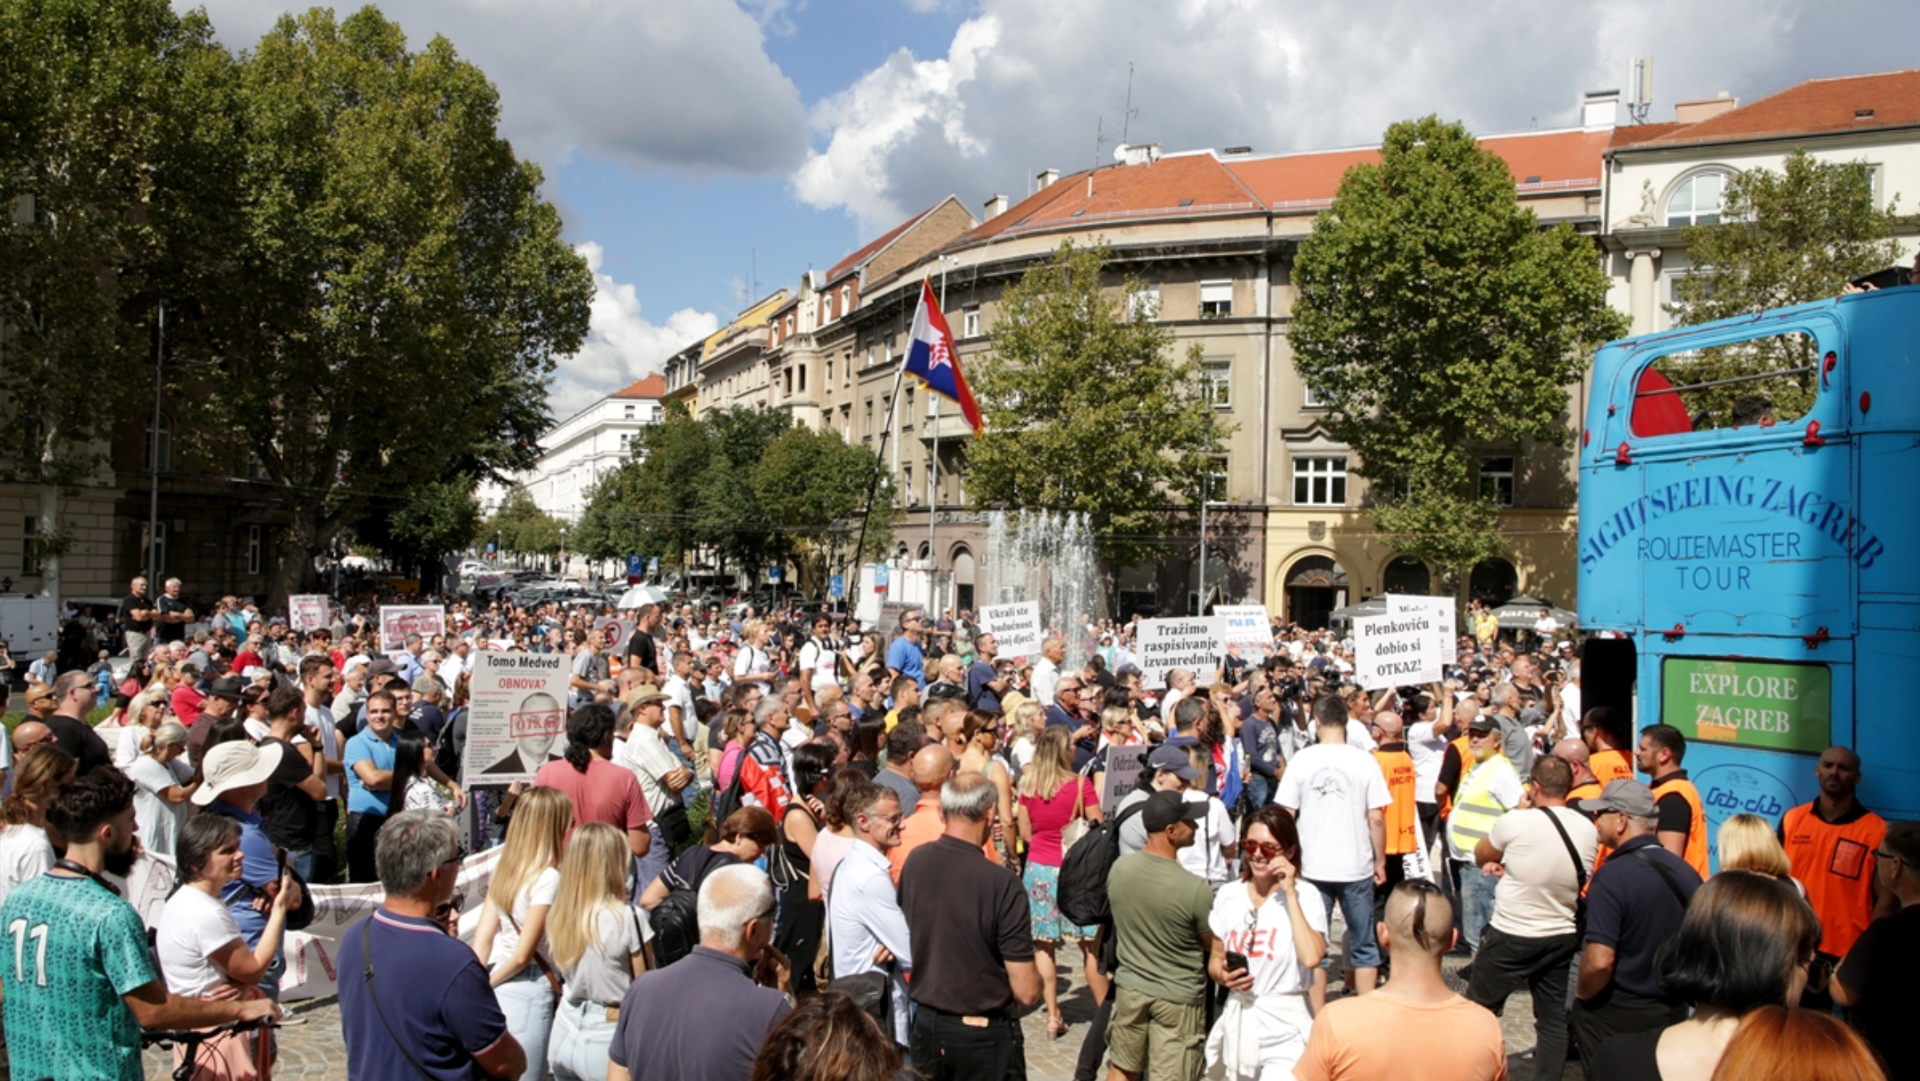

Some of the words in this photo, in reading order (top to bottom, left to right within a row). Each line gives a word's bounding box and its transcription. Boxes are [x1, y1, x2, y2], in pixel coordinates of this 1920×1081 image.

[1580, 475, 1754, 574] SIGHTSEEING
[1760, 478, 1884, 570] ZAGREB
[1637, 532, 1802, 561] ROUTEMASTER
[1676, 566, 1751, 591] TOUR
[989, 607, 1015, 619] Ukrali
[1016, 608, 1029, 616] ste
[1157, 622, 1208, 636] Tražimo
[1365, 617, 1429, 636] Plenkoviću
[1144, 637, 1218, 653] raspisivanje
[1375, 641, 1408, 656] dobio
[1410, 638, 1421, 651] si
[487, 655, 516, 667] Tomo
[518, 656, 560, 669] Medved
[1144, 652, 1217, 668] izvanrednih
[1376, 659, 1422, 676] OTKAZ!
[498, 677, 547, 690] OBNOVA?
[1689, 672, 1799, 701] EXPLORE
[1695, 704, 1791, 734] ZAGREB
[8, 918, 49, 987] 11
[1225, 927, 1277, 962] NE!
